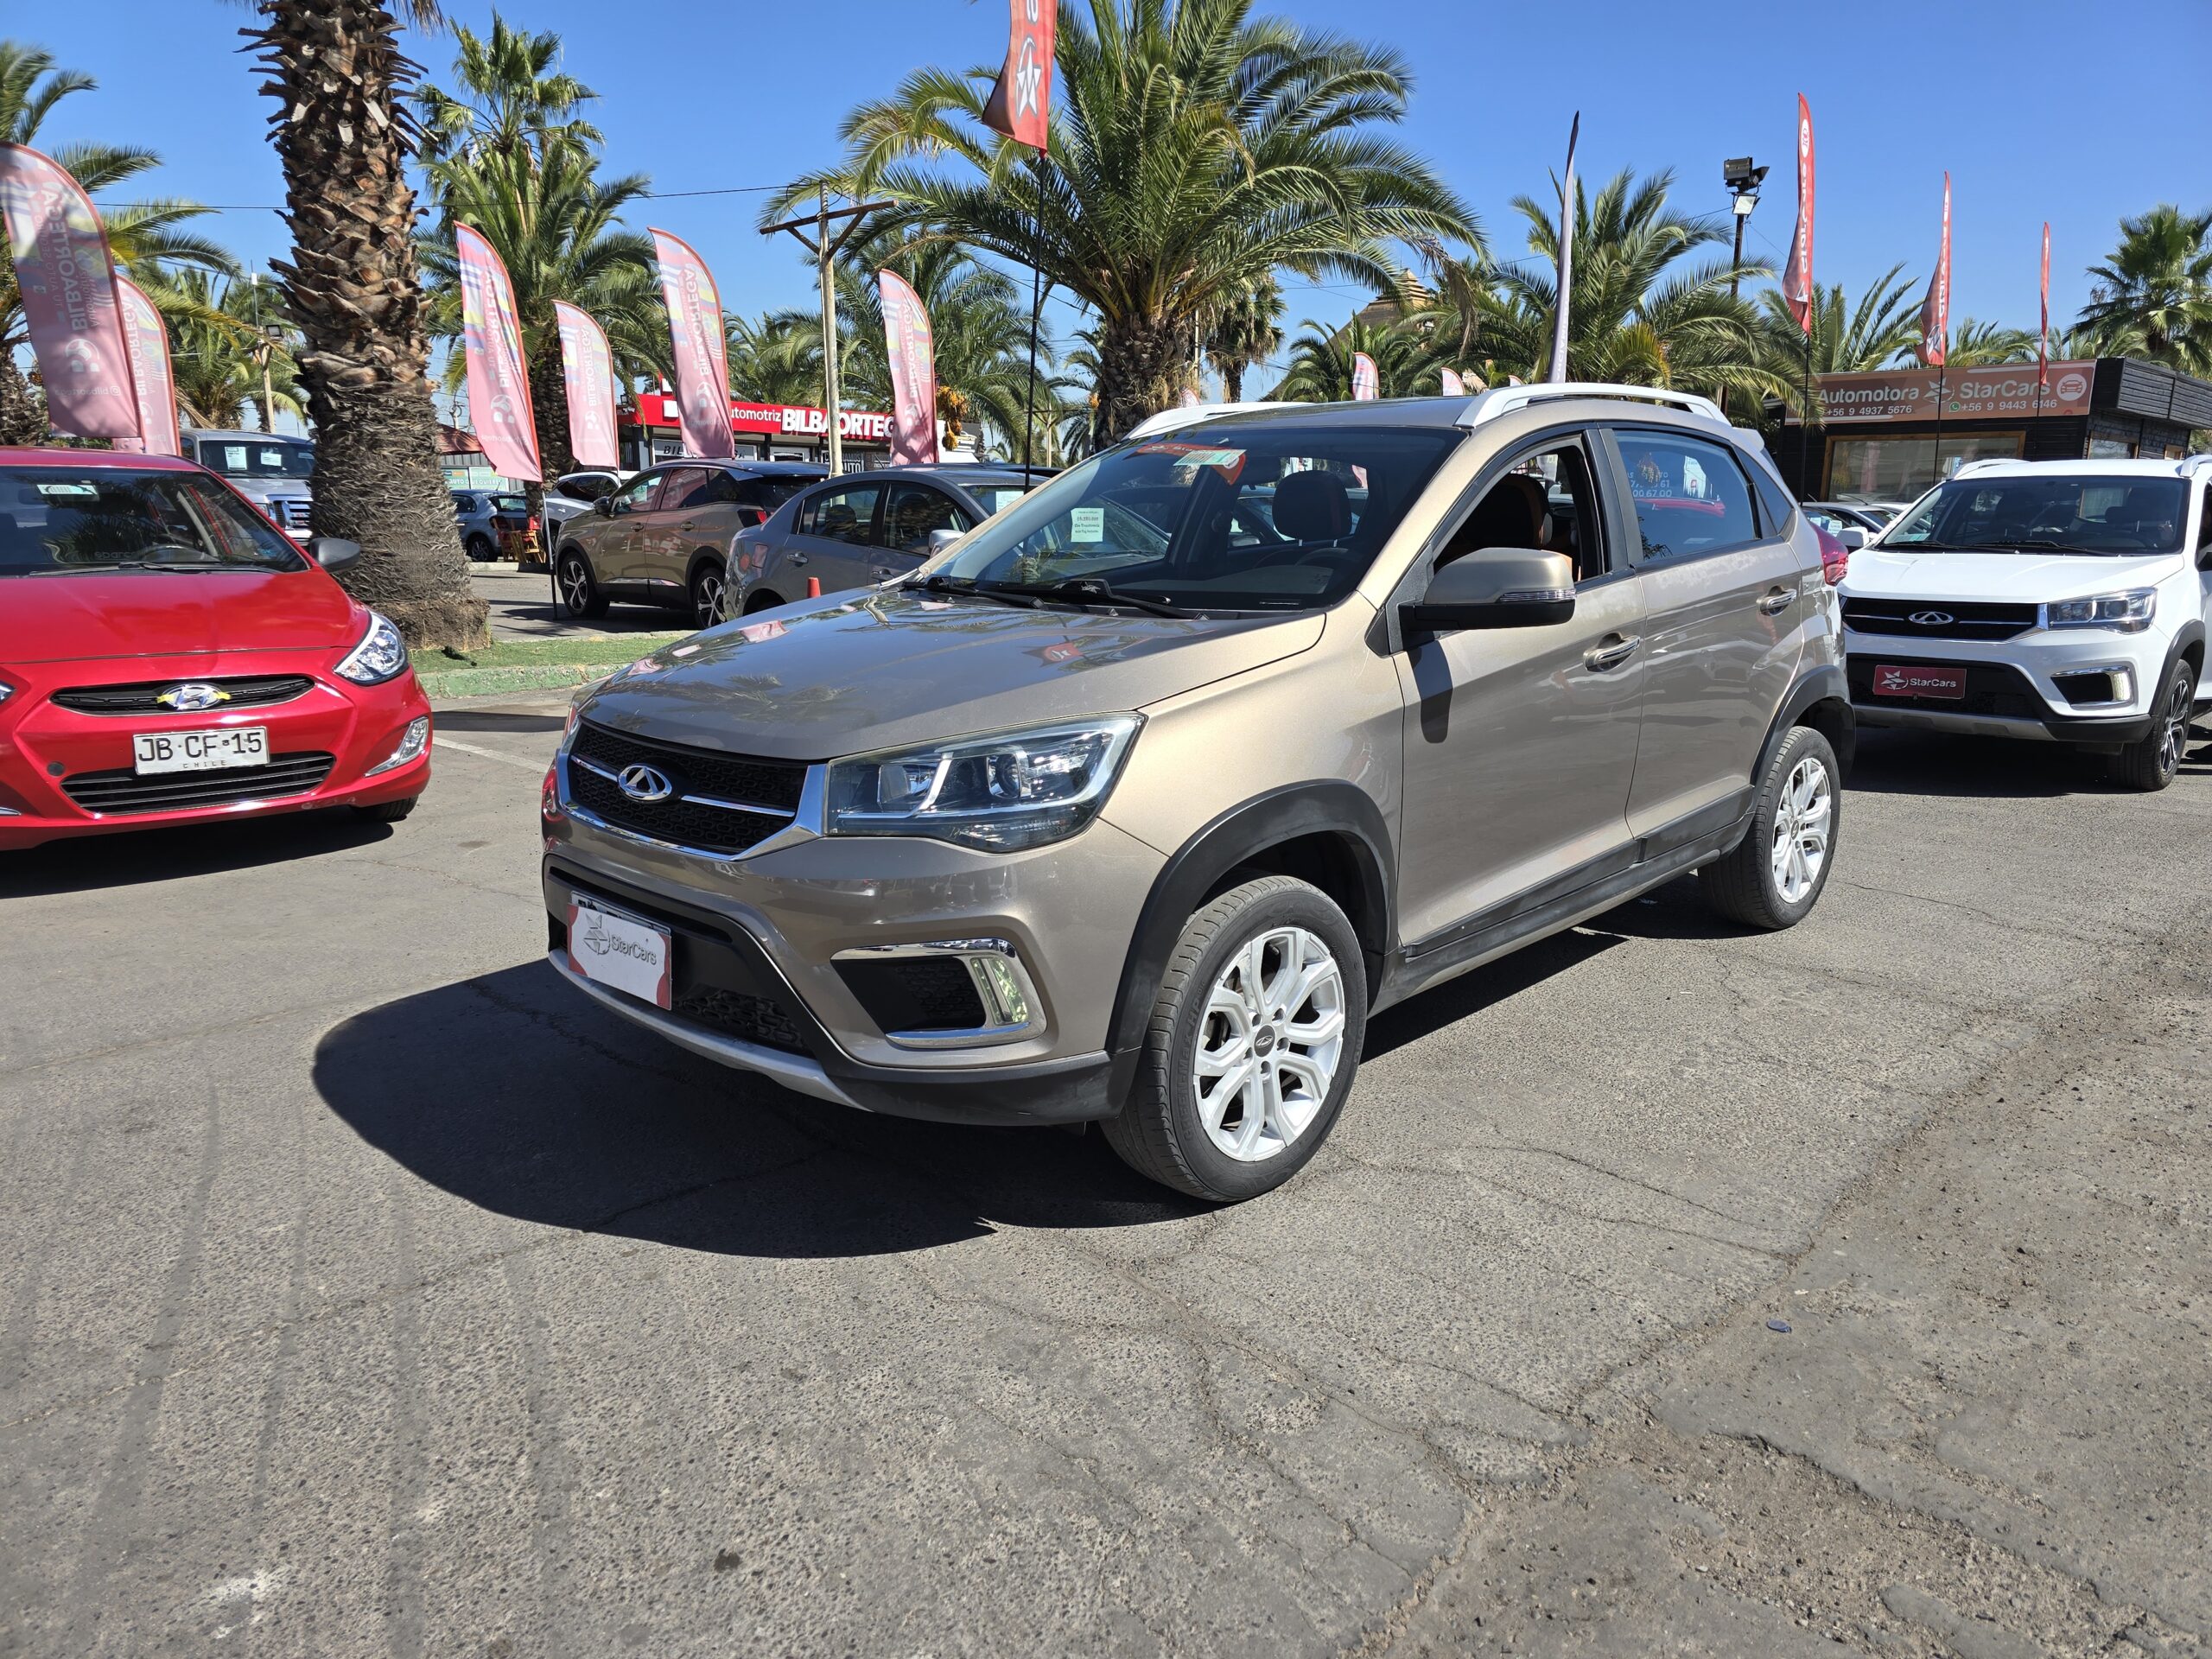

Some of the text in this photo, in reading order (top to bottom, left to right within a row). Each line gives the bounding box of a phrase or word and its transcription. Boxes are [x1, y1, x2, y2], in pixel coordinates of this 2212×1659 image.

[1819, 380, 2050, 404] Automotora StarCars
[1827, 405, 1912, 416] +56 9 4937 5676
[1961, 403, 1981, 411] +56
[1987, 402, 1993, 410] 9
[1999, 401, 2026, 410] 9443
[731, 407, 781, 423] tomotriz
[1910, 677, 1957, 688] StarCars
[611, 934, 657, 965] StarCars
